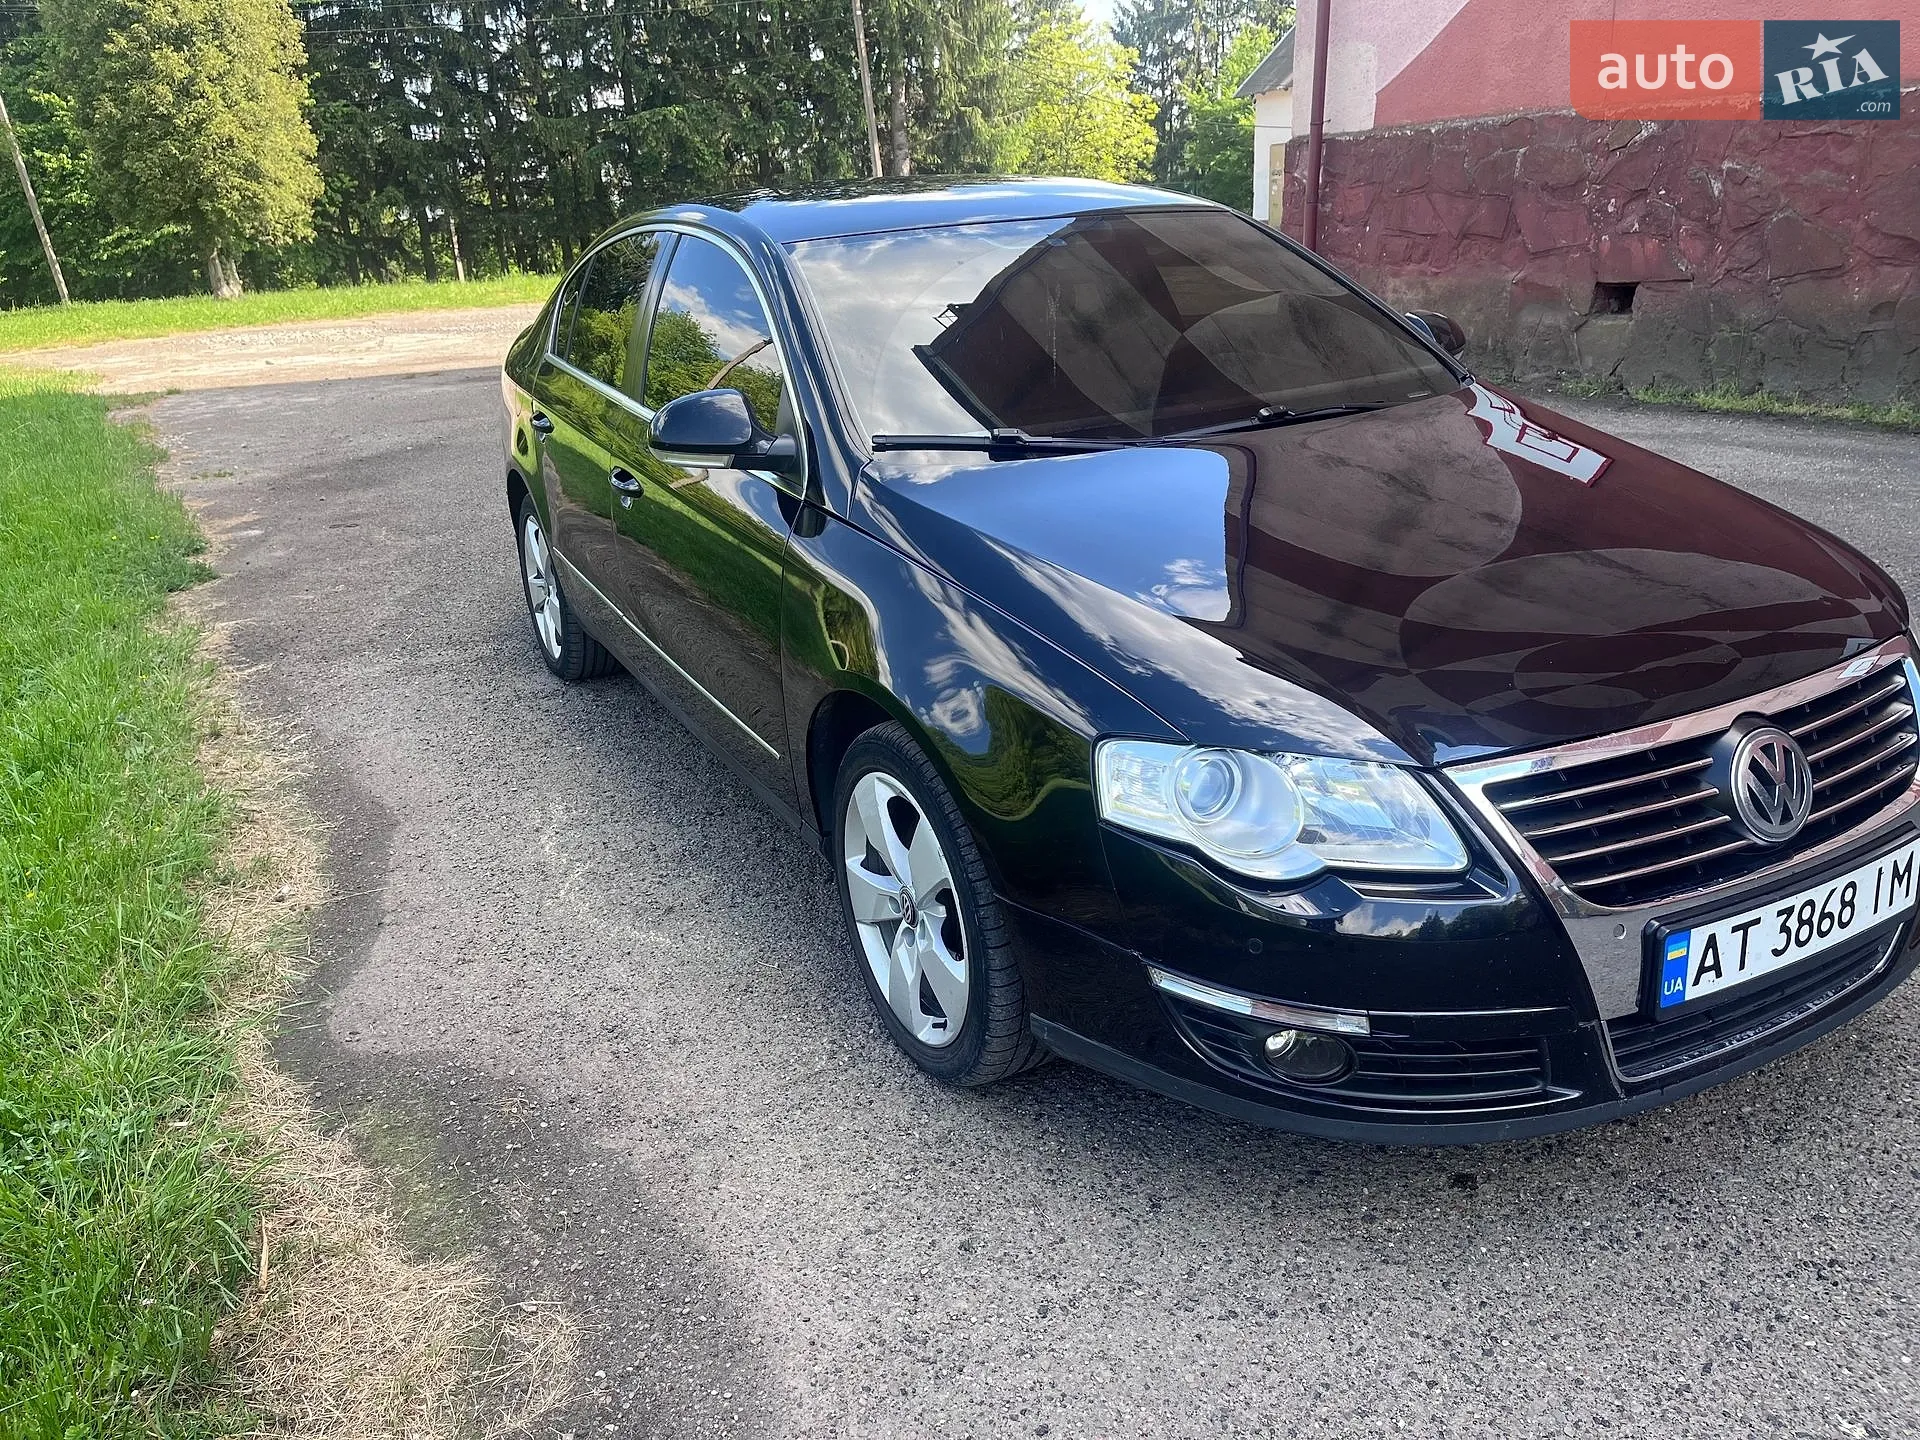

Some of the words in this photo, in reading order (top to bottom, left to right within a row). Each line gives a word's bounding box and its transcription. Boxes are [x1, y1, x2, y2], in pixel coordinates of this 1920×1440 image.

[1692, 916, 1762, 987] AT
[1770, 880, 1858, 958] 3868
[1873, 850, 1915, 916] IM
[1663, 976, 1684, 996] UA
